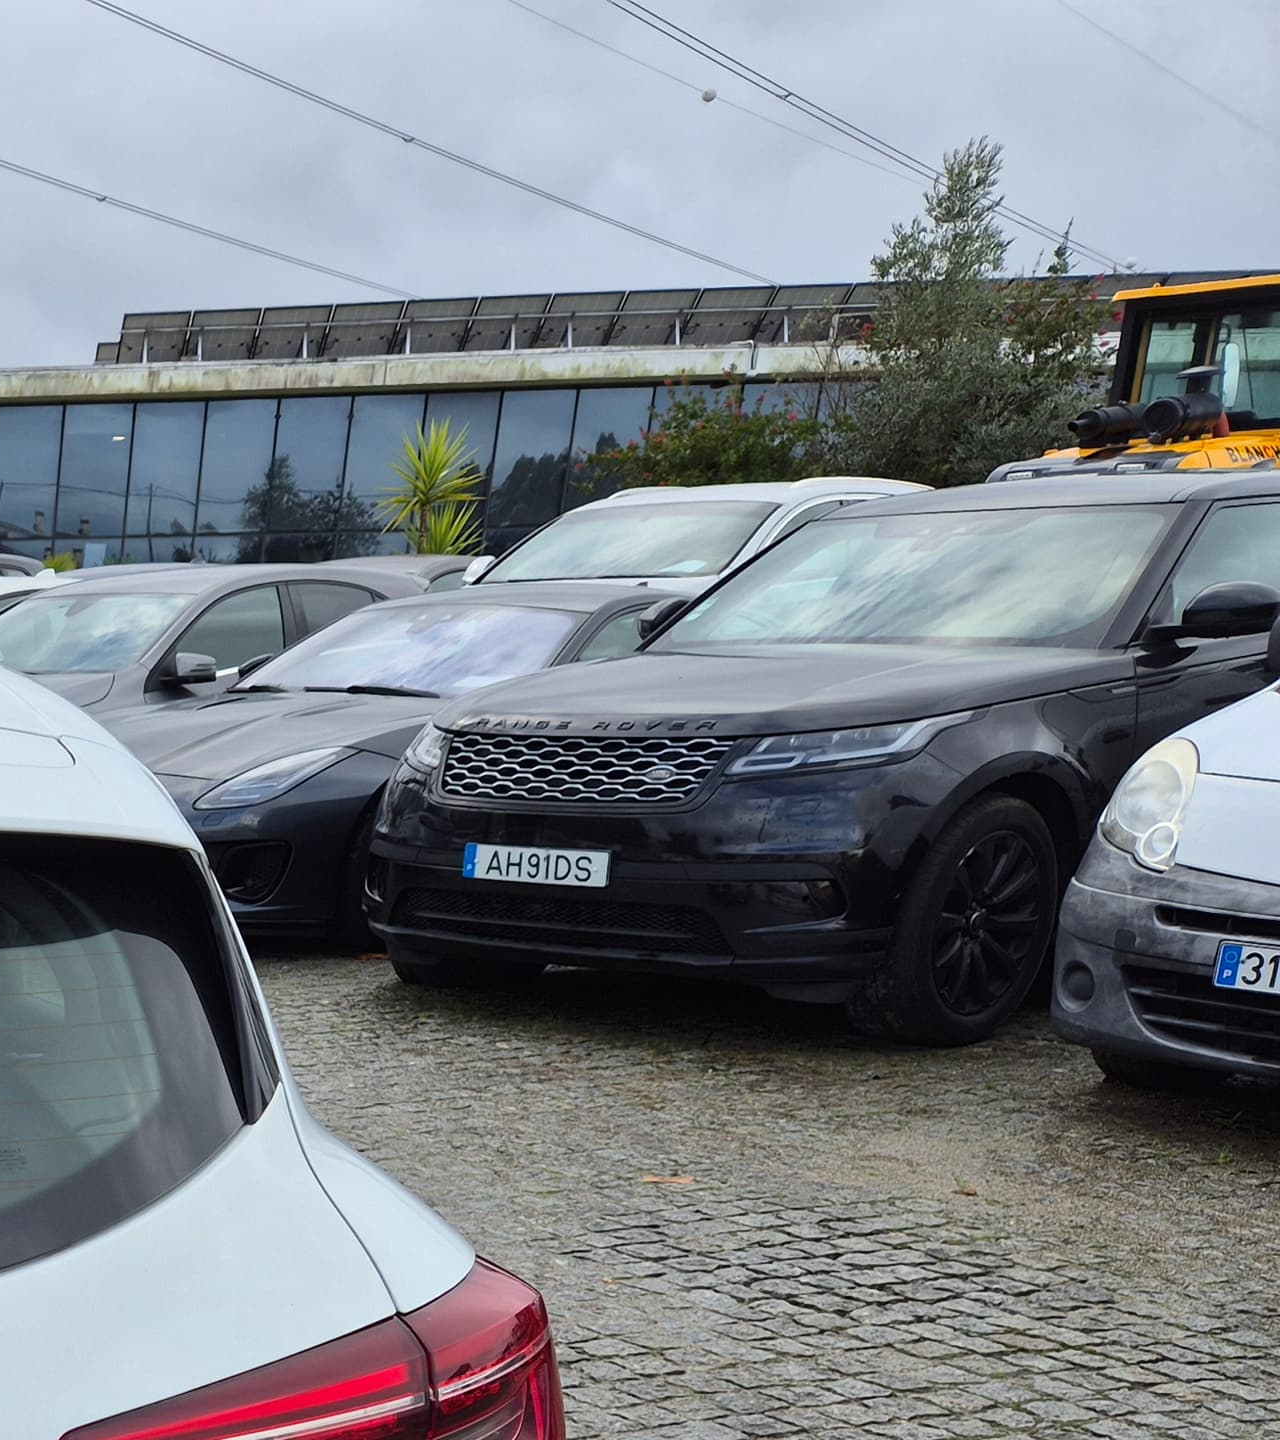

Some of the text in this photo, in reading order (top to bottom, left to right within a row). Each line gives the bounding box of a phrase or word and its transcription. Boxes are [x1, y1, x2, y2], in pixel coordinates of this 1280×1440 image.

[592, 719, 719, 732] ROVER
[485, 850, 593, 882] AH91DS
[1223, 969, 1232, 979] P
